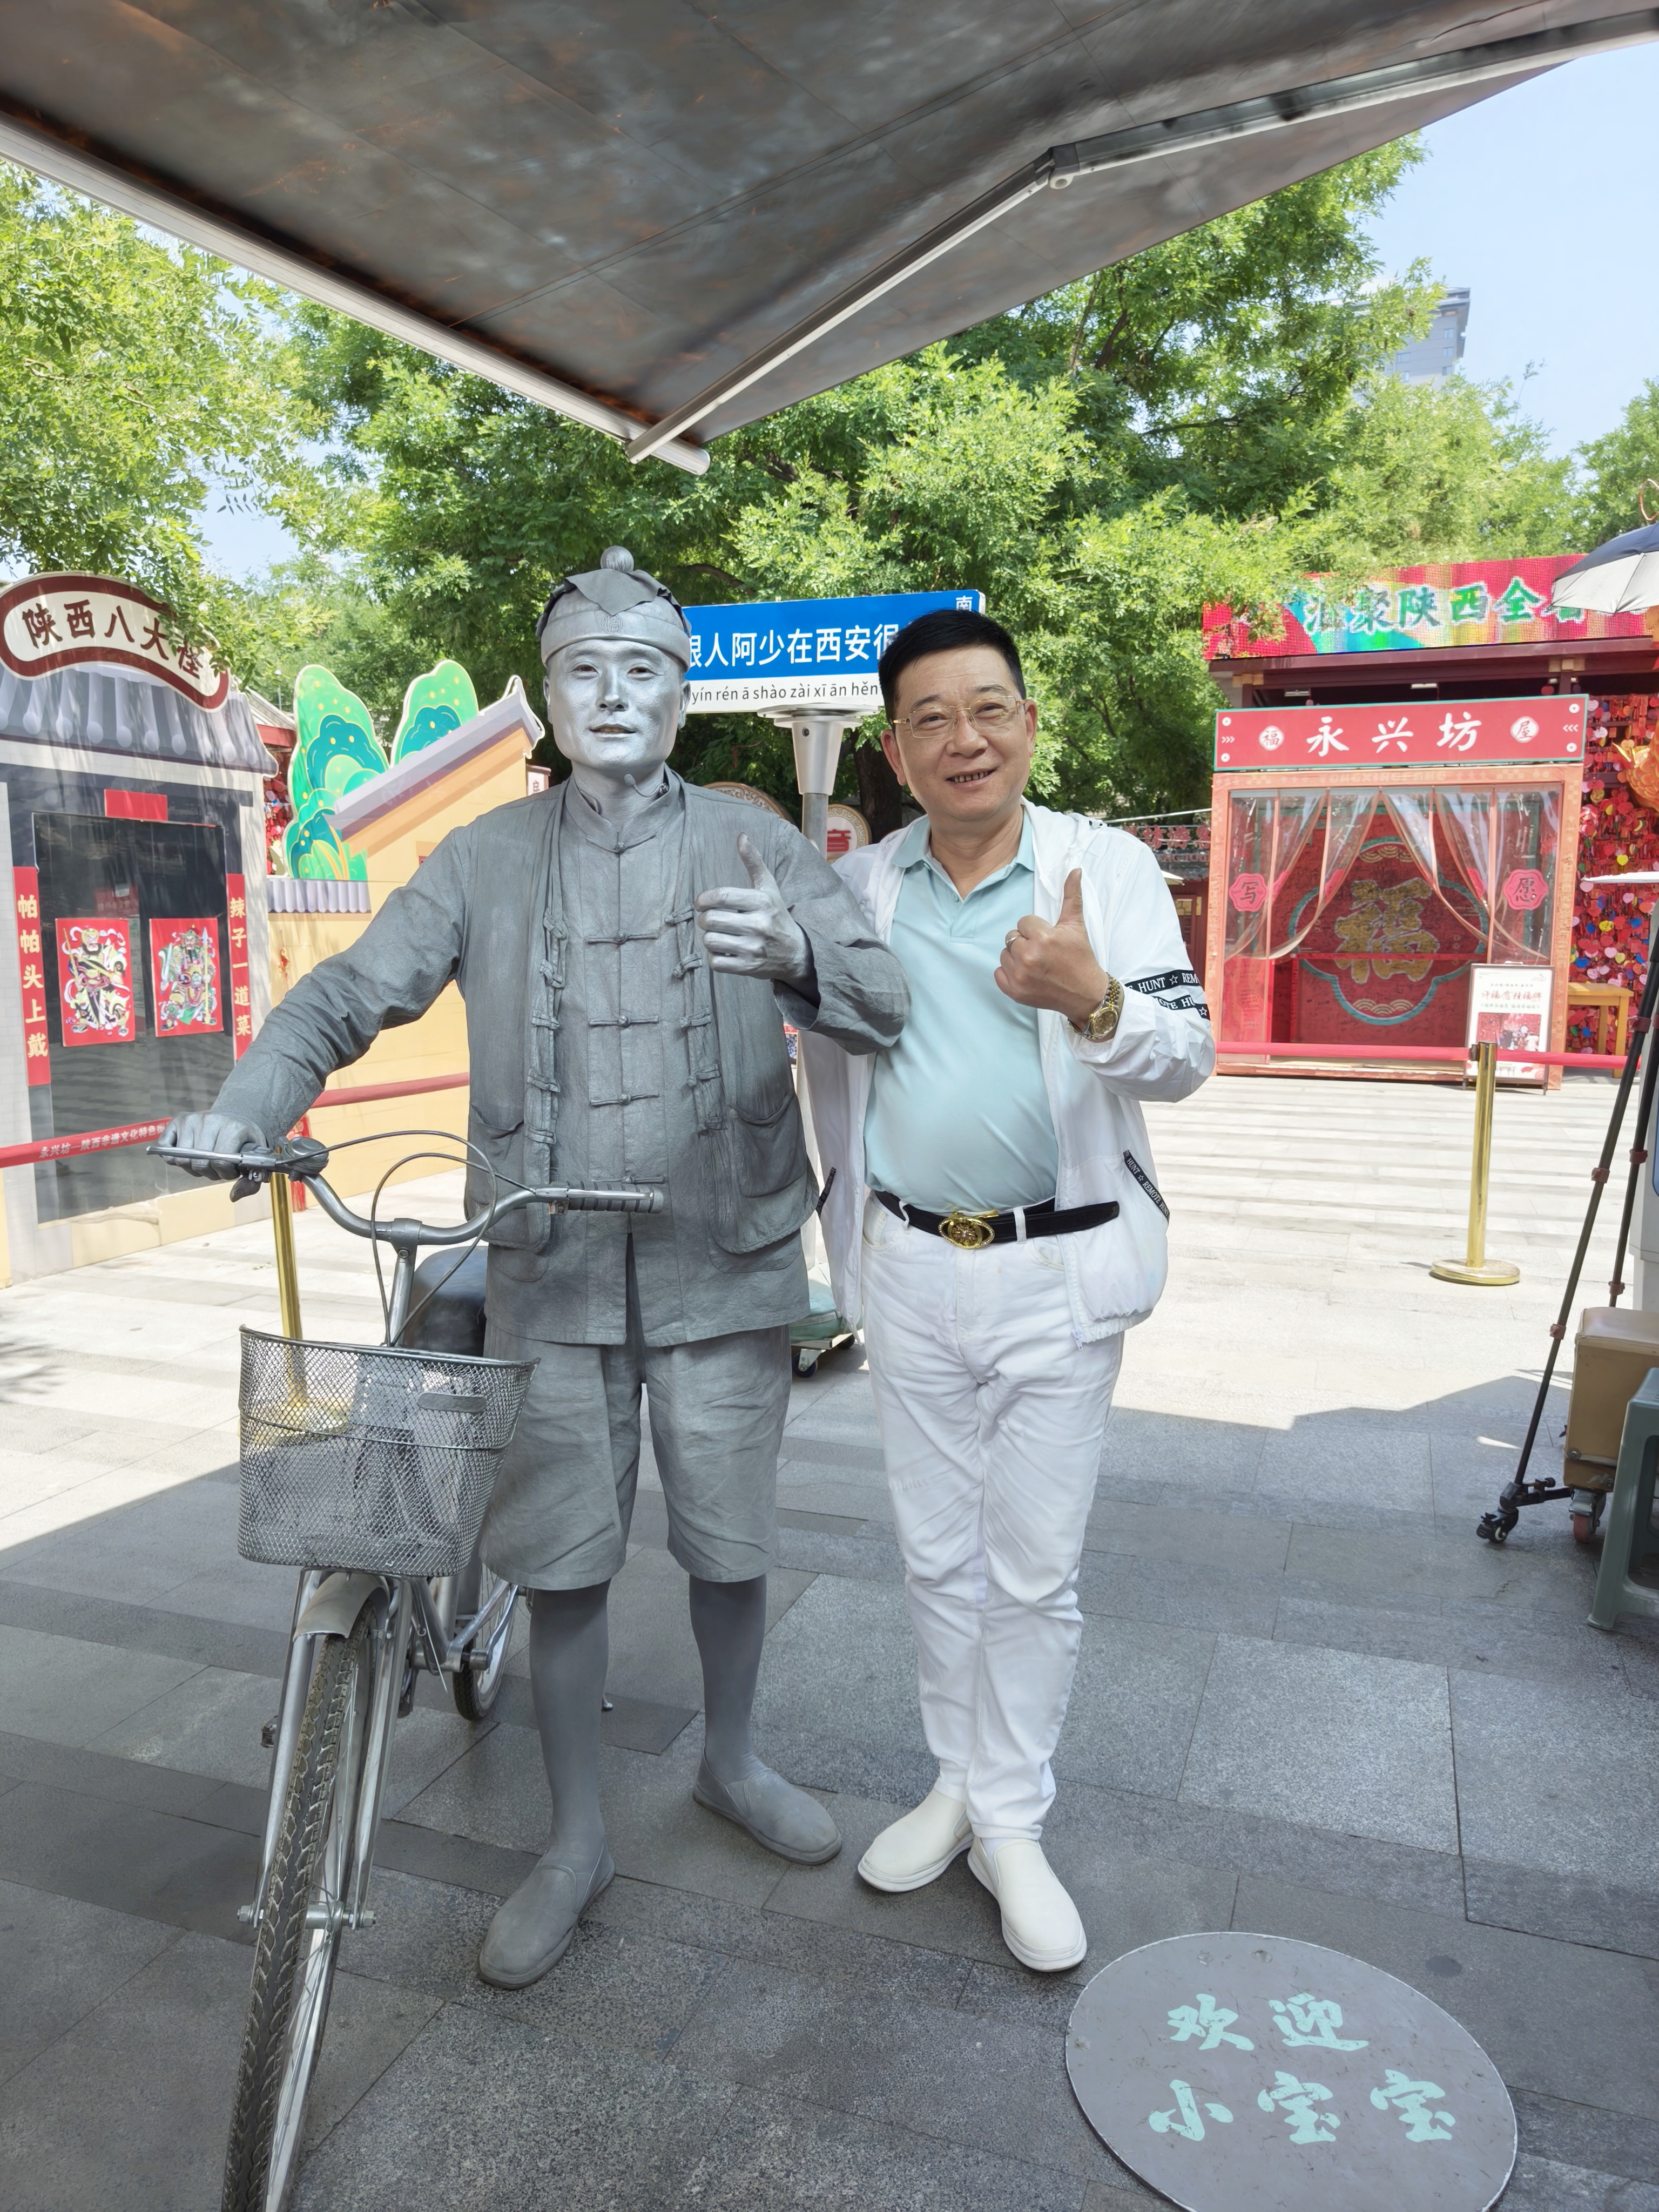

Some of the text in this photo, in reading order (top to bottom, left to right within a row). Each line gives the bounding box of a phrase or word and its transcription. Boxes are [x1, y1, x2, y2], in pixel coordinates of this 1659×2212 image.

[956, 595, 973, 611] 南
[22, 599, 204, 680] 陕西八大怪
[692, 681, 878, 705] yín rén ā shào zài xī ān hěn
[1263, 711, 1534, 757] 福 永兴坊 屋
[1240, 877, 1536, 904] 写 愿
[1333, 876, 1440, 984] 福
[18, 894, 49, 1058] 帕帕头上戴
[229, 897, 252, 1036] 辣子一道菜
[1138, 977, 1165, 993] HUNT
[1126, 1158, 1141, 1175] HUNT
[1142, 1181, 1161, 1204] REMOTE
[1167, 1993, 1370, 2052] 欢迎
[1148, 2069, 1456, 2144] 小宝宝
